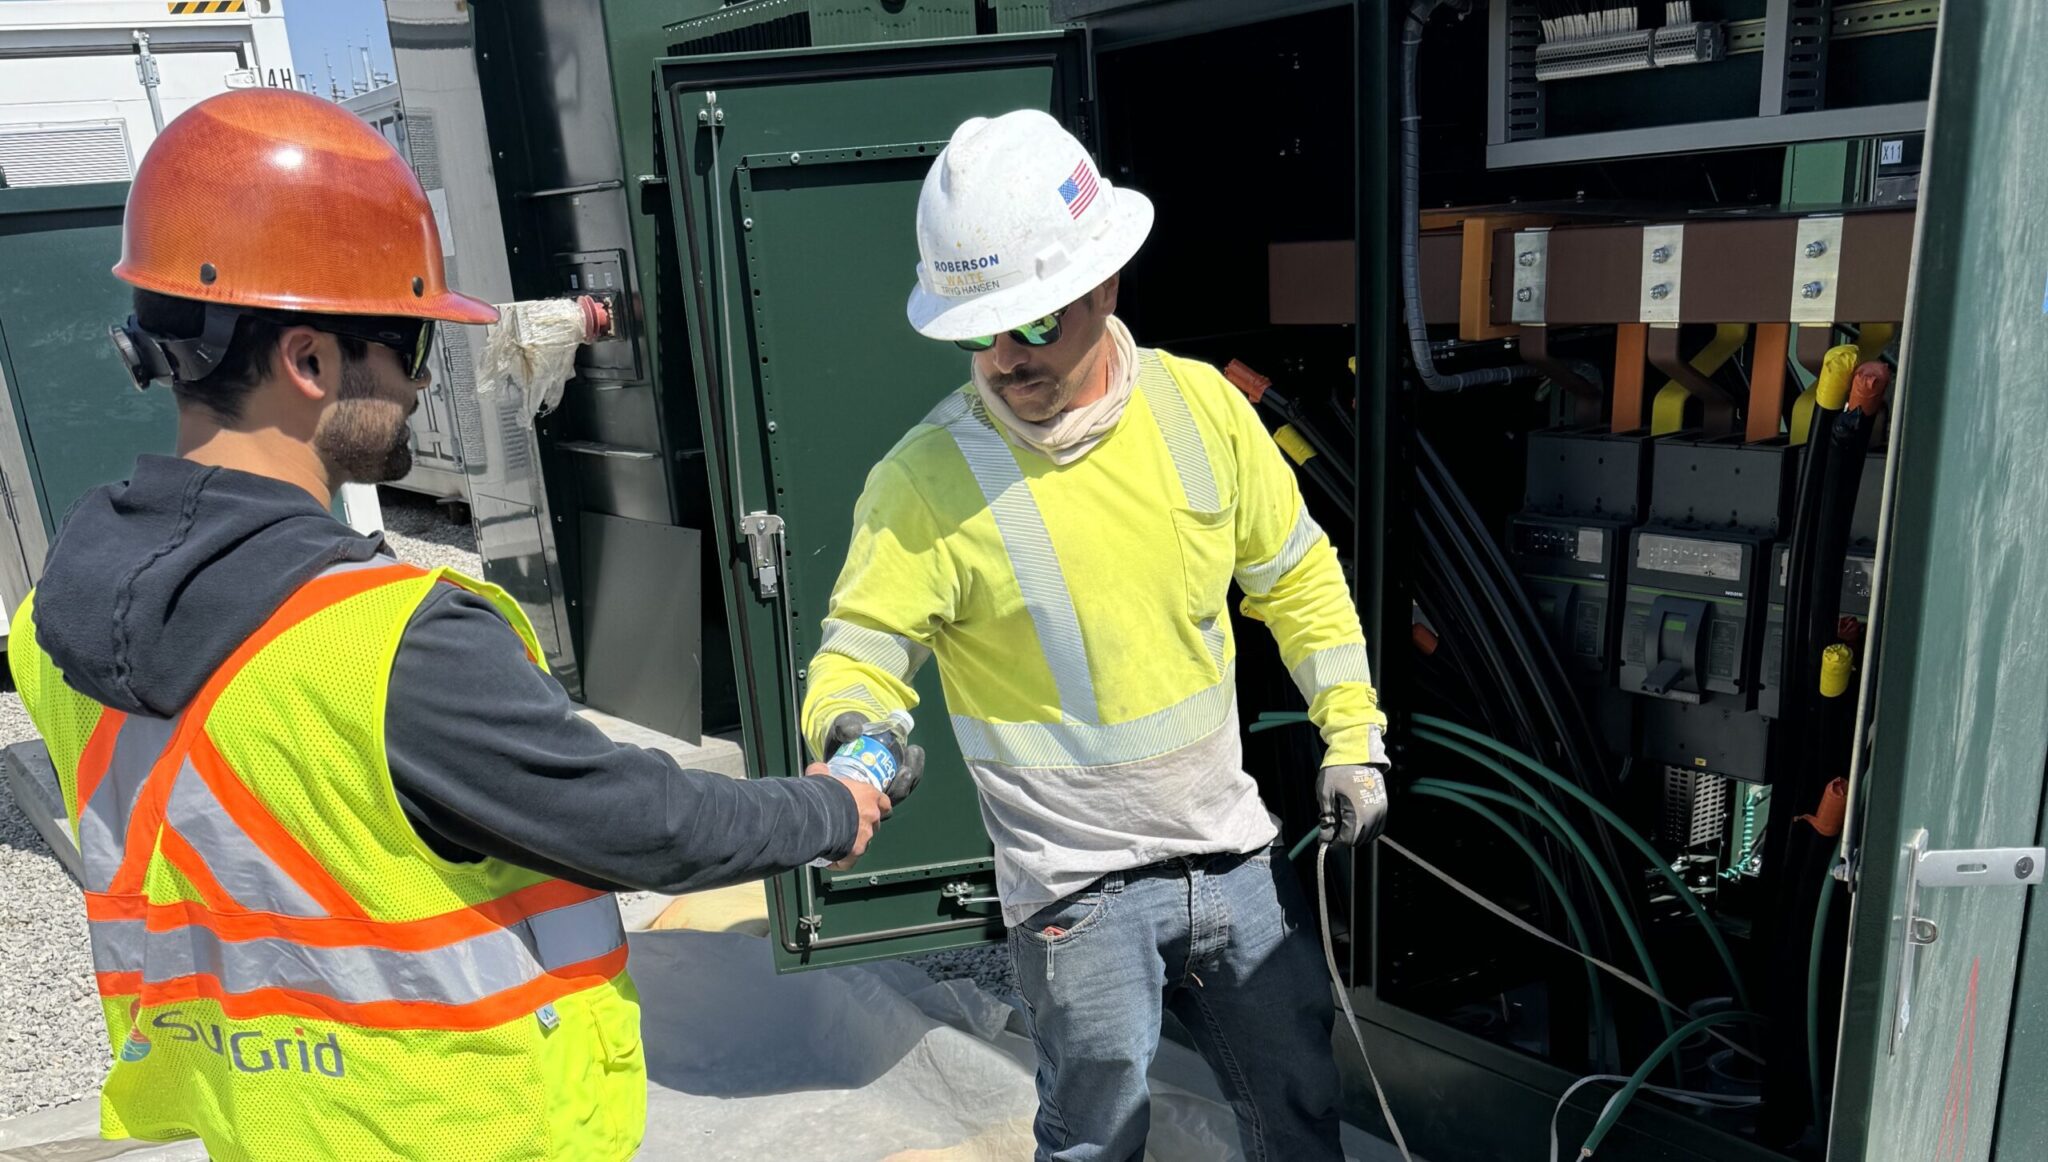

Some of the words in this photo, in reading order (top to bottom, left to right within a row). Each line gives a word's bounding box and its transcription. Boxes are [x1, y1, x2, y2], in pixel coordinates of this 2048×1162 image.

[1883, 144, 1902, 161] X11
[934, 253, 1000, 273] ROBERSON
[946, 272, 984, 287] WAITE
[962, 280, 1000, 295] HANSEN
[152, 1010, 346, 1078] SuGrid
